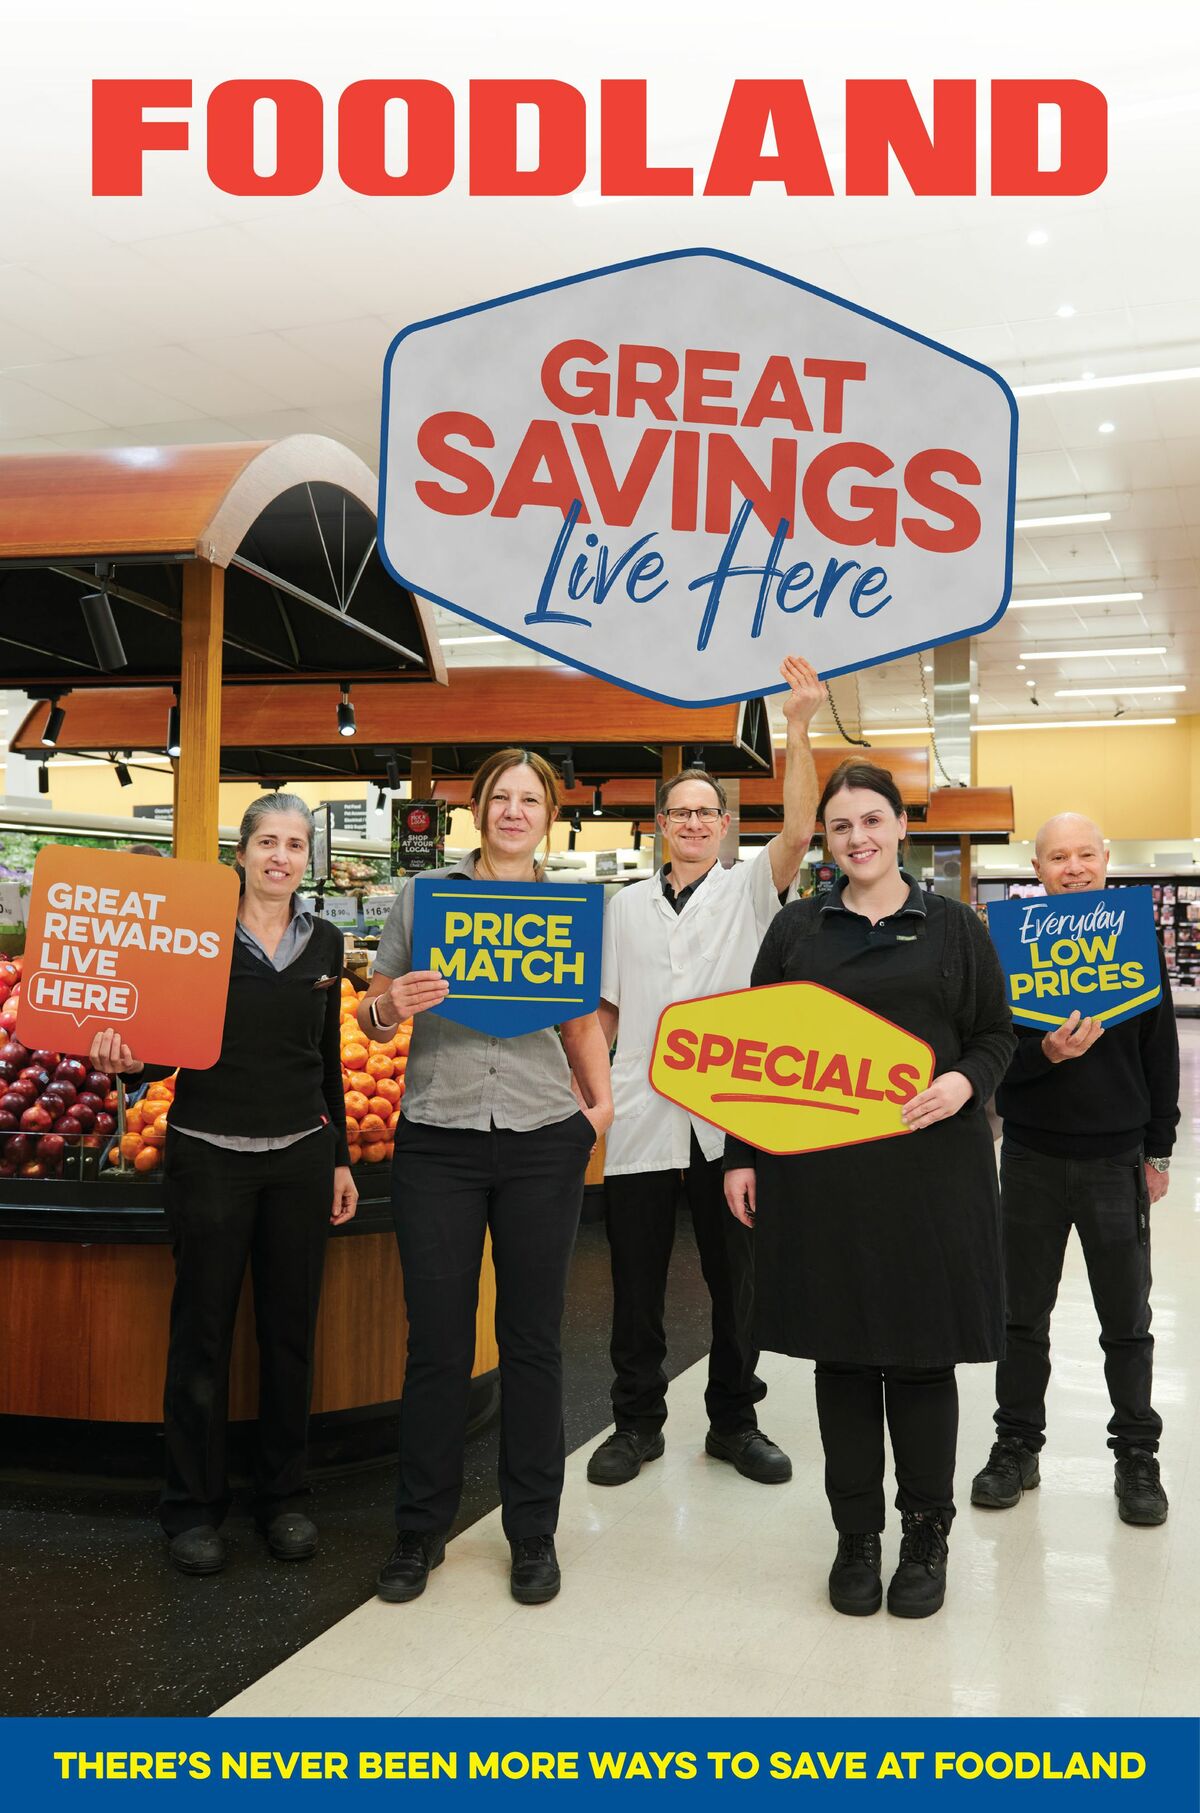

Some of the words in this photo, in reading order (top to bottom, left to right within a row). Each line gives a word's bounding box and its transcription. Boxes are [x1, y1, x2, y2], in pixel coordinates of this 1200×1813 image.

[540, 338, 868, 434] GREAT
[415, 411, 982, 553] SAVINGS
[525, 499, 669, 627] Live
[688, 499, 893, 652] Here
[47, 882, 166, 920] GREAT
[43, 911, 221, 959] REWARDS
[444, 911, 573, 948] PRICE
[1019, 901, 1126, 944] Everyday
[39, 942, 119, 977] LIVE
[429, 947, 585, 985] MATCH
[1029, 935, 1117, 970] LOW
[35, 977, 131, 1015] HERE
[1009, 961, 1146, 1001] PRICES
[663, 1028, 921, 1105] SPECIALS
